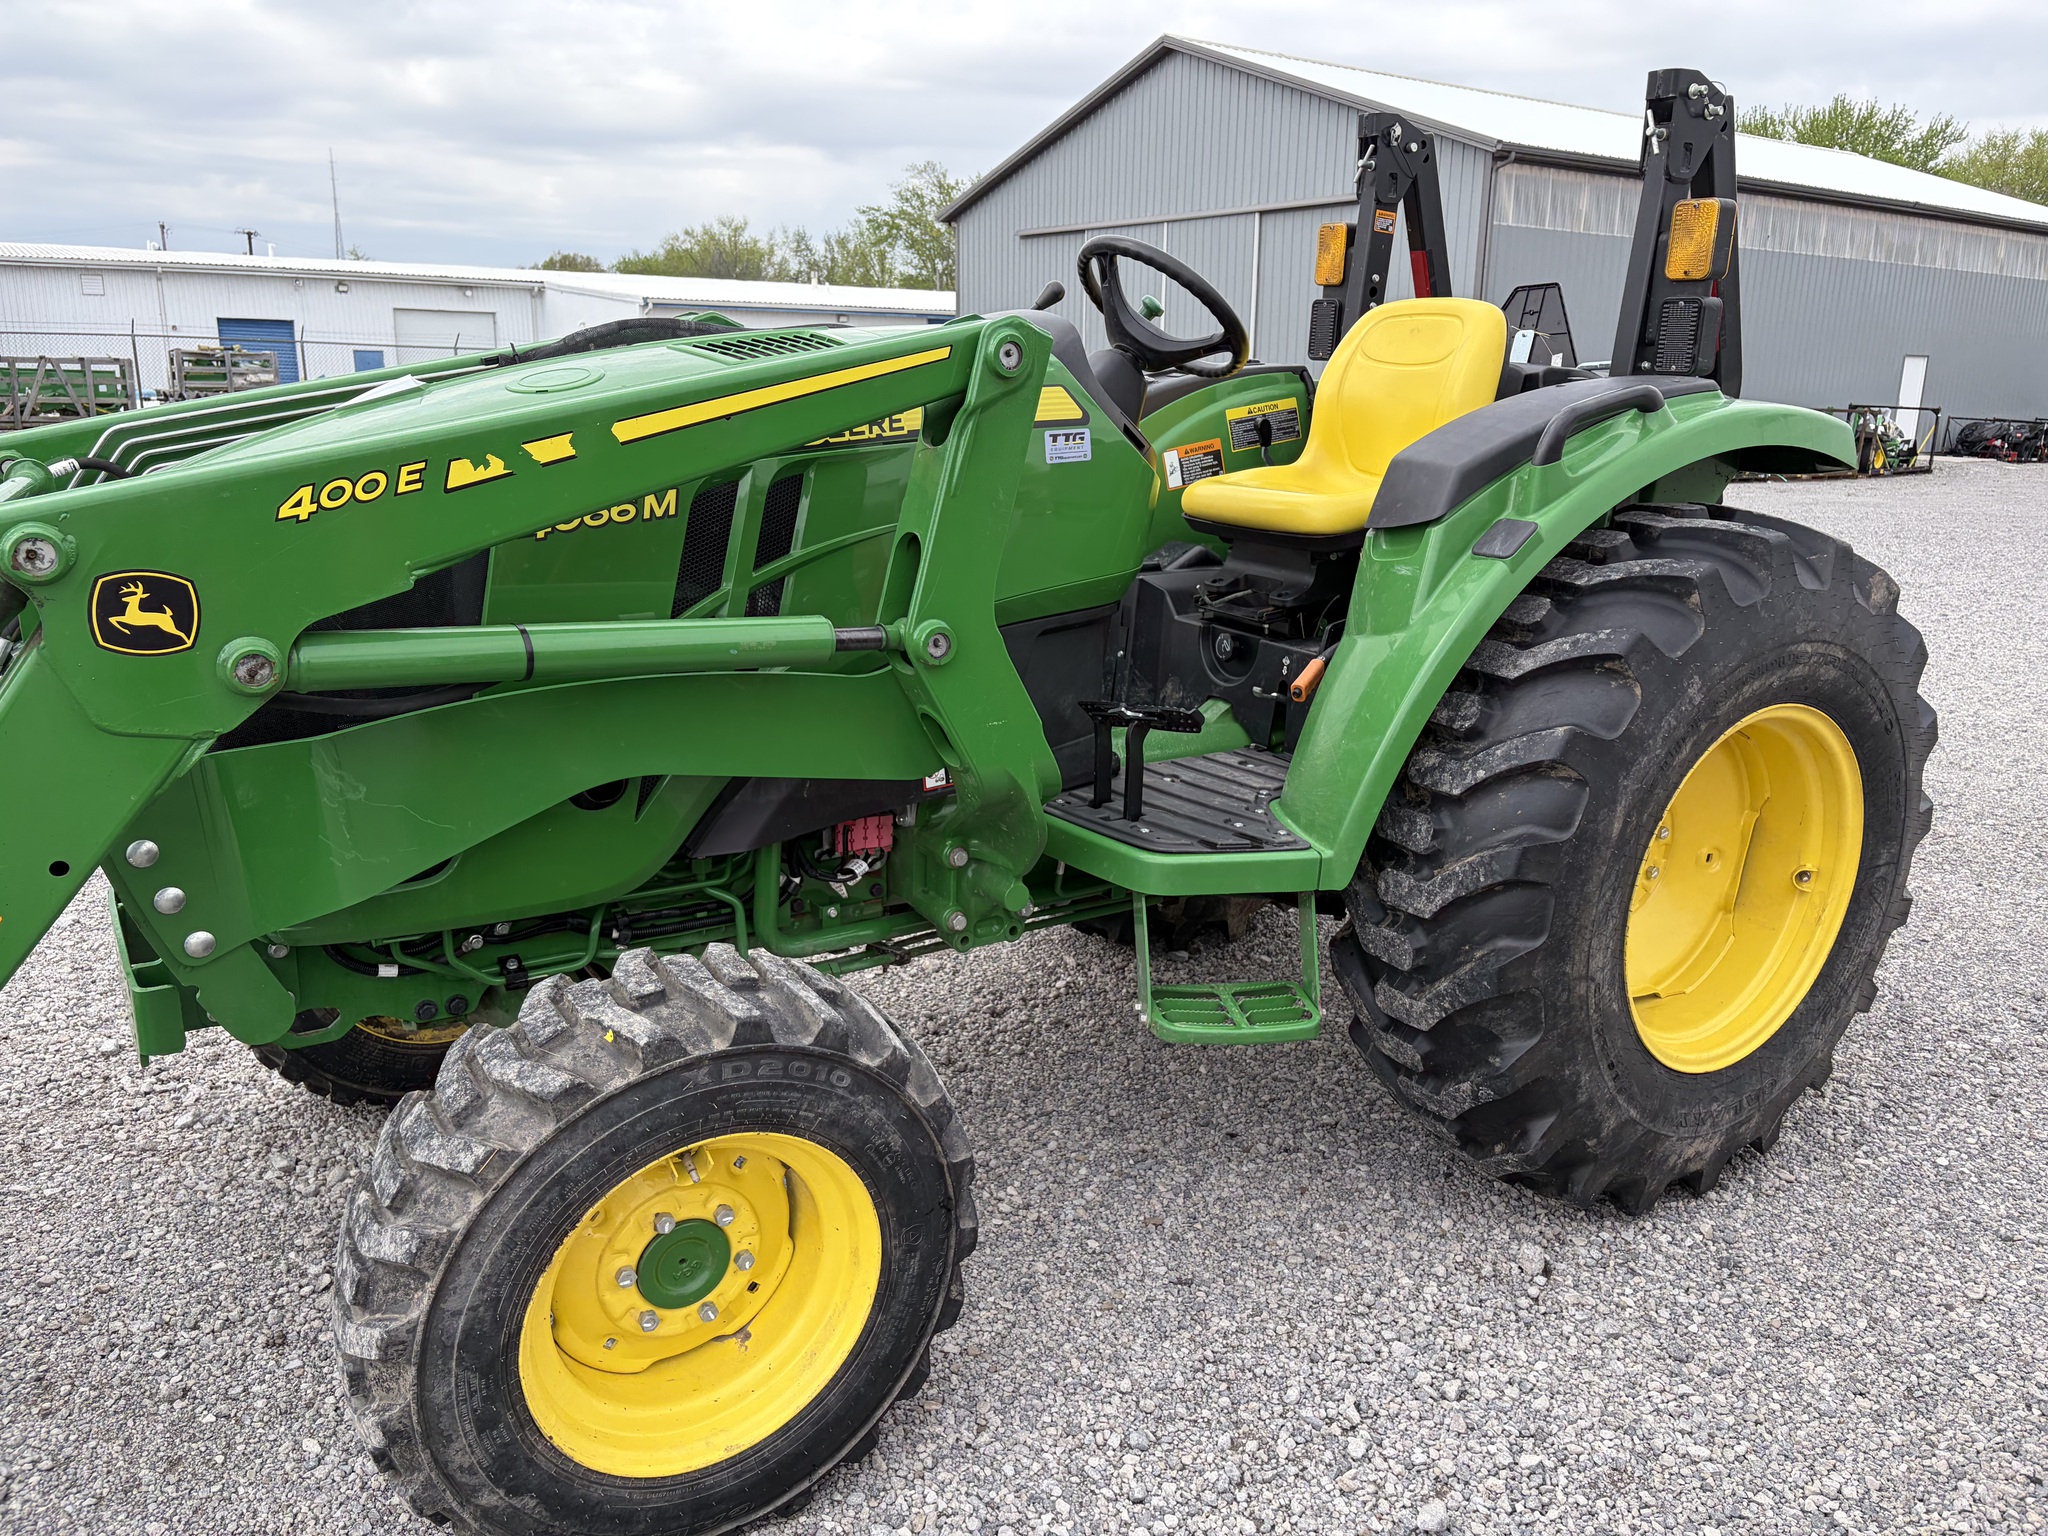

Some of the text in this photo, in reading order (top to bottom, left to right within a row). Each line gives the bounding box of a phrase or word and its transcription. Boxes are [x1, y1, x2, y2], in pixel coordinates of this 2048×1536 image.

[1252, 403, 1279, 414] CAUTION
[1049, 432, 1085, 446] TTG
[1189, 443, 1215, 454] WARNING
[275, 459, 428, 524] 400 E
[642, 487, 679, 521] M
[468, 1150, 558, 1256] TUBELESS
